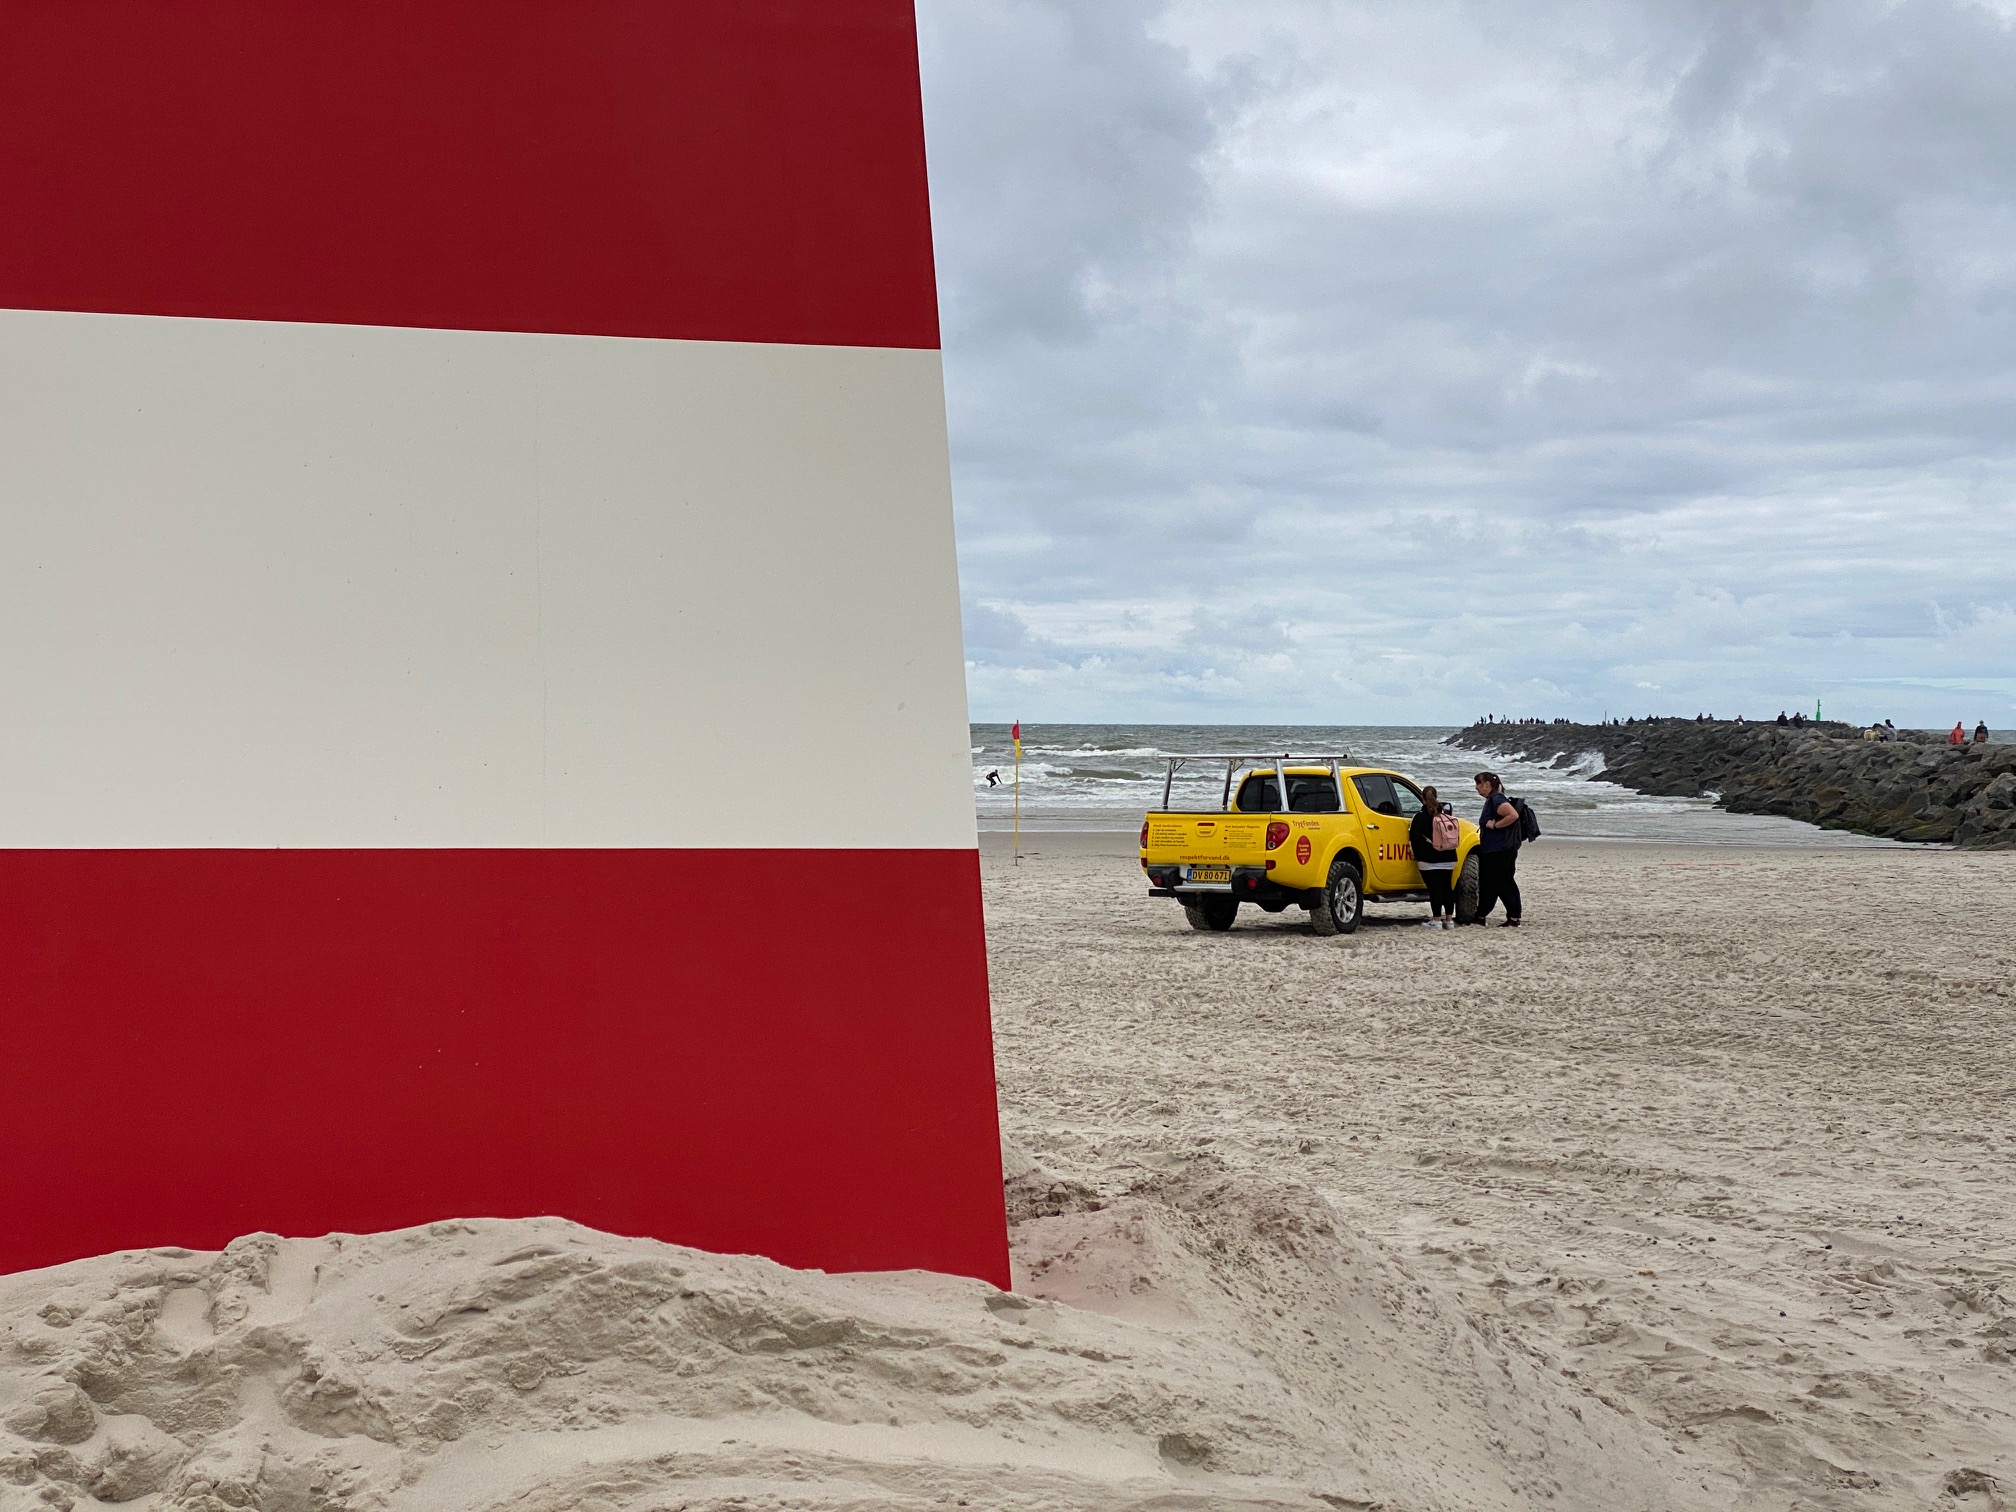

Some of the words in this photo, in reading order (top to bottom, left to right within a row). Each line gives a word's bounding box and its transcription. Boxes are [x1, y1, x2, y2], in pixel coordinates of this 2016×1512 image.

[1387, 844, 1413, 860] LIVR
[1192, 871, 1202, 880] DV
[1203, 871, 1214, 880] 80
[1214, 871, 1227, 880] 671
